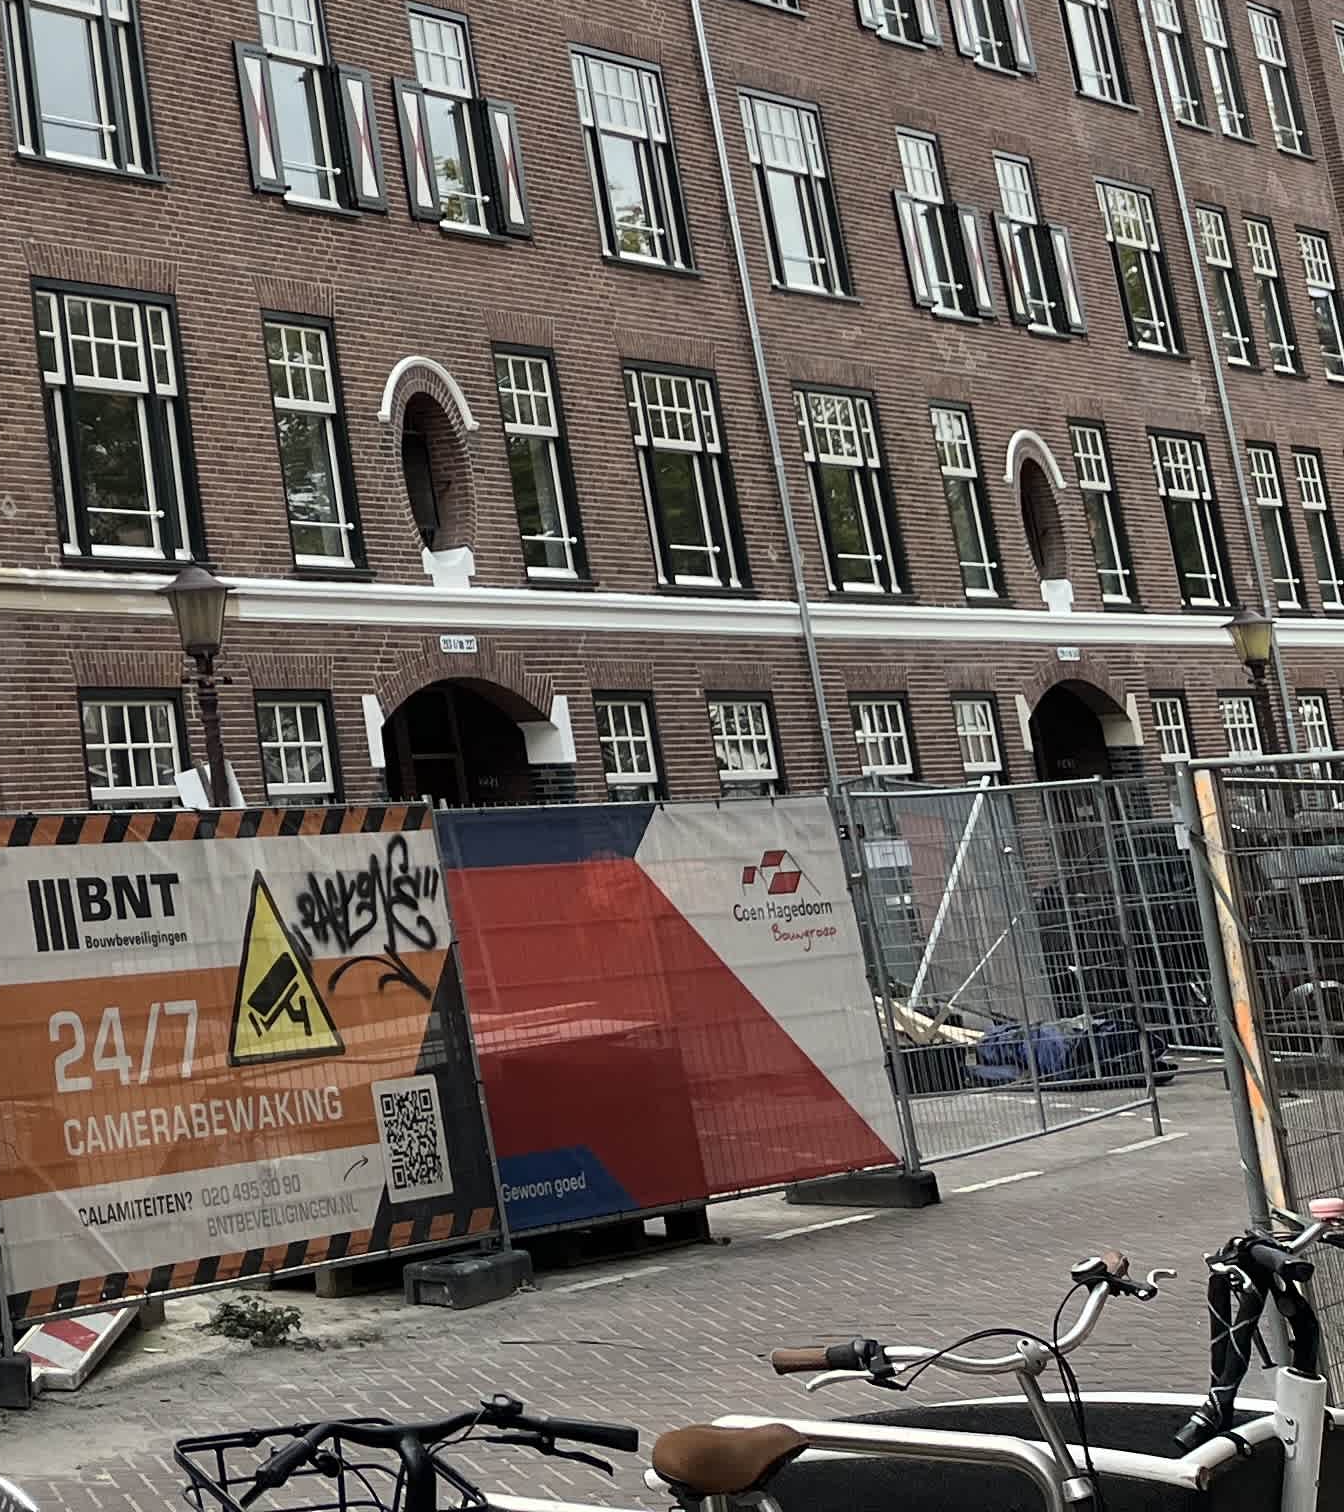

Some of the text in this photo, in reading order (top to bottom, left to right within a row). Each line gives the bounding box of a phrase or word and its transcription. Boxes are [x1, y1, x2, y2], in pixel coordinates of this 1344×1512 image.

[76, 872, 180, 922] BNT
[733, 897, 832, 922] Coen Hagedoorn
[84, 931, 188, 949] Bouwbeveiligingen
[49, 999, 199, 1093] 24/7
[63, 1086, 343, 1156] CAMERABEWAKING
[78, 1191, 193, 1227] CALAMITEITEN?
[201, 1185, 230, 1208] 020
[233, 1180, 260, 1202] 495
[283, 1173, 301, 1193] 90
[500, 1171, 587, 1202] Gewoon goed
[207, 1193, 359, 1237] BNTBEVEILIGINGEN.NL
